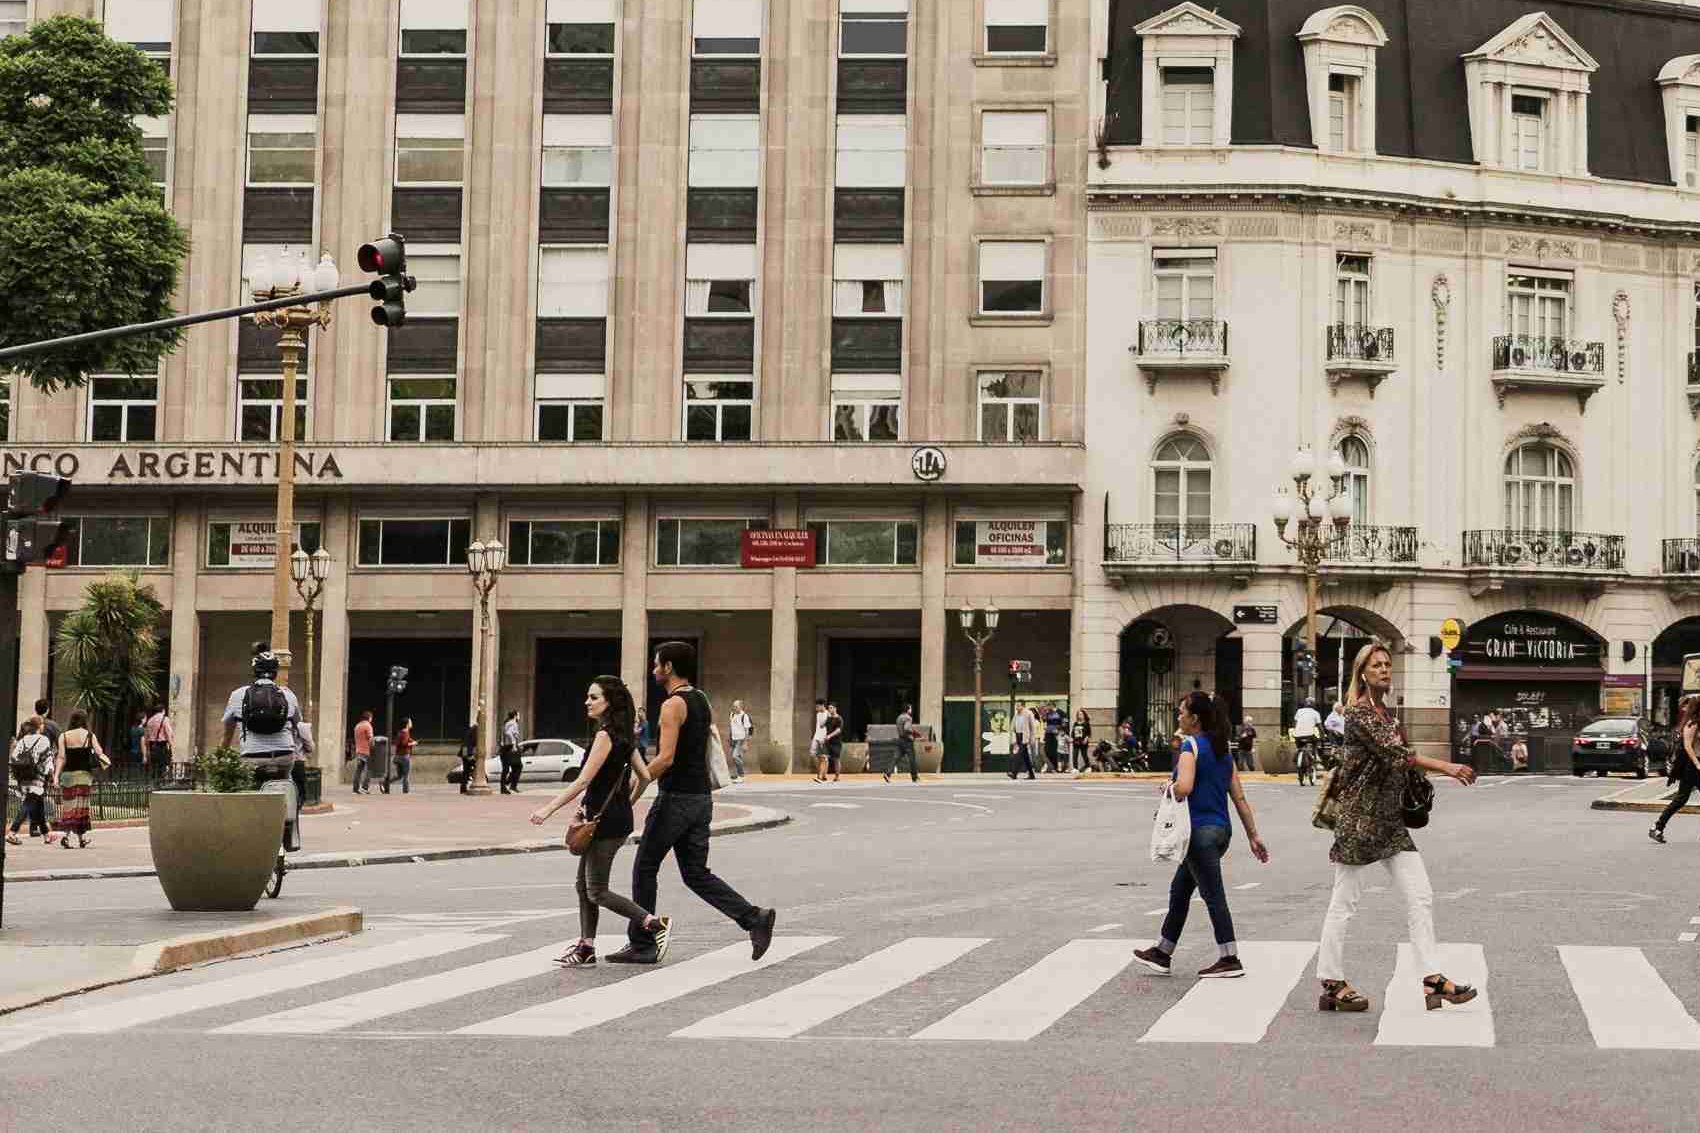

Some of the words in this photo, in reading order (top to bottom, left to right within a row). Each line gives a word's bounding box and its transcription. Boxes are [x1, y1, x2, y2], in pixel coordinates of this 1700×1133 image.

[108, 452, 343, 478] ARGENTINA
[988, 533, 1034, 543] OFICINAS
[1486, 638, 1515, 658] GRAN
